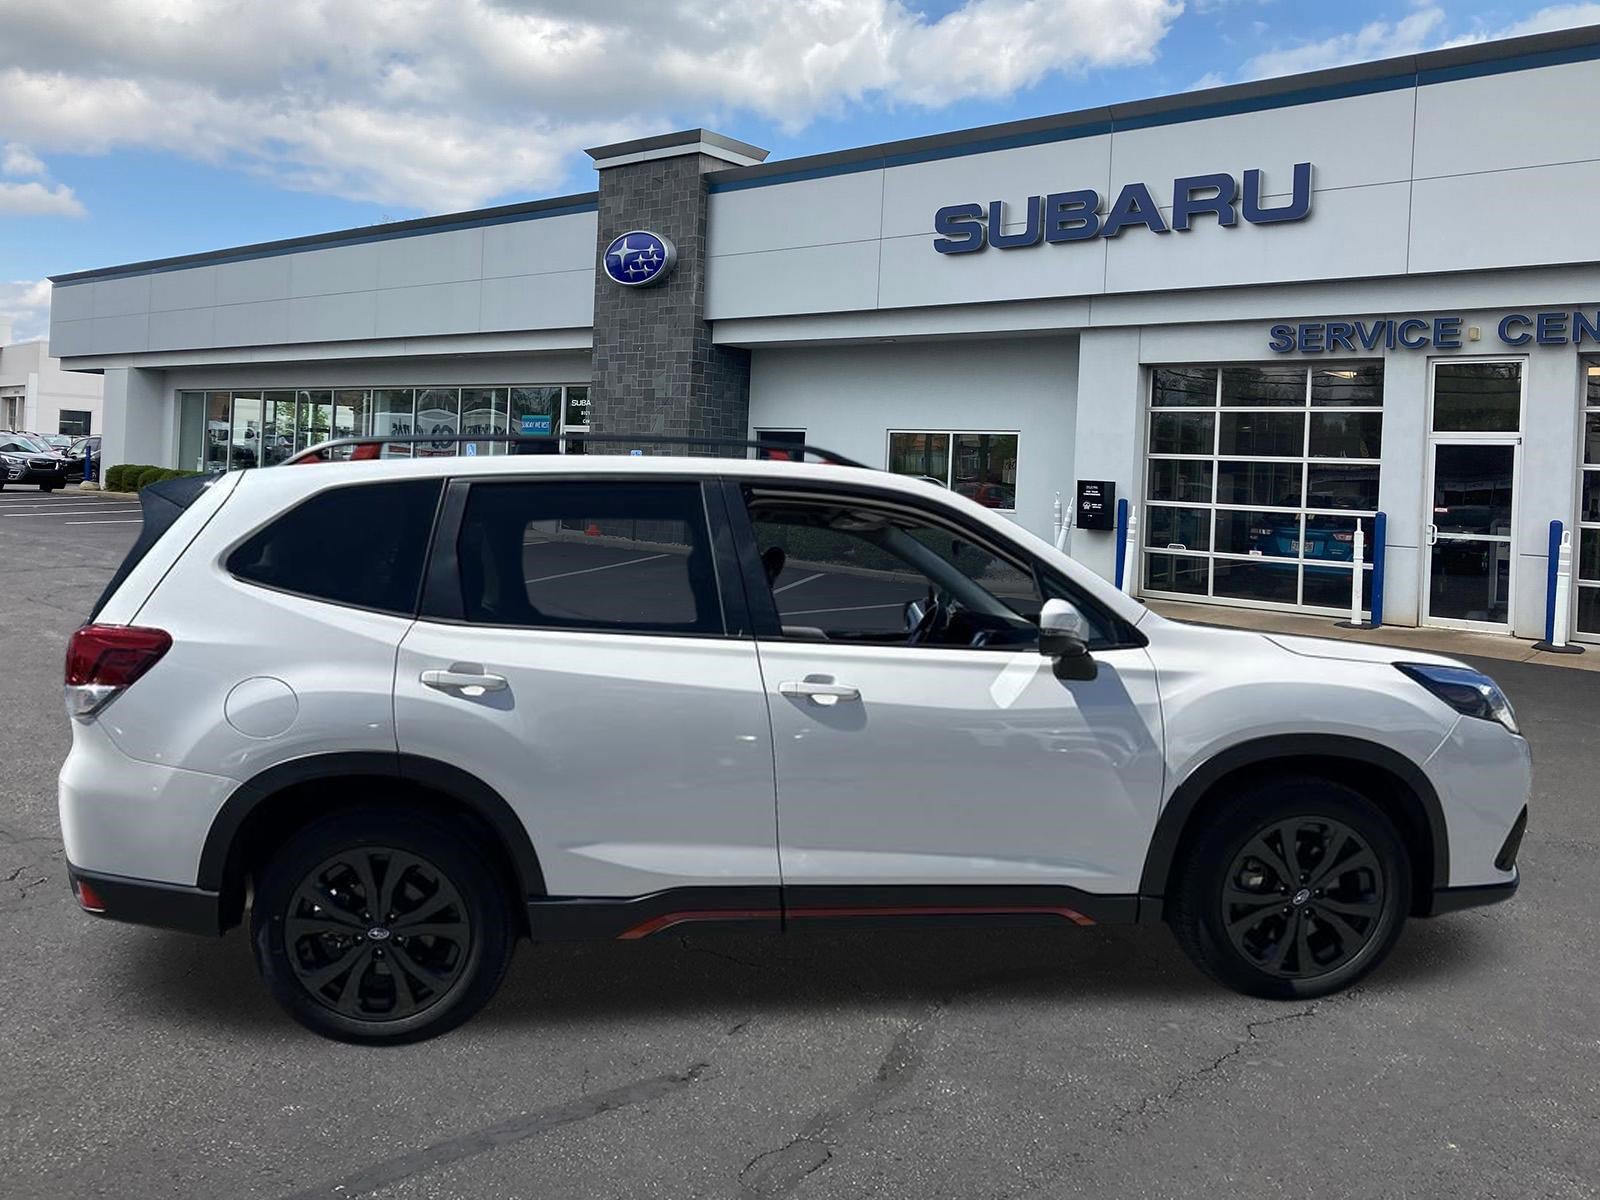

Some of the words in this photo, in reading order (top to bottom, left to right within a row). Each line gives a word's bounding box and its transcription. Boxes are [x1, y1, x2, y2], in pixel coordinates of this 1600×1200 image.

[934, 162, 1312, 254] SUBARU
[1269, 317, 1463, 353] SERVICE
[1498, 311, 1600, 346] CEN
[571, 399, 592, 407] SUBA
